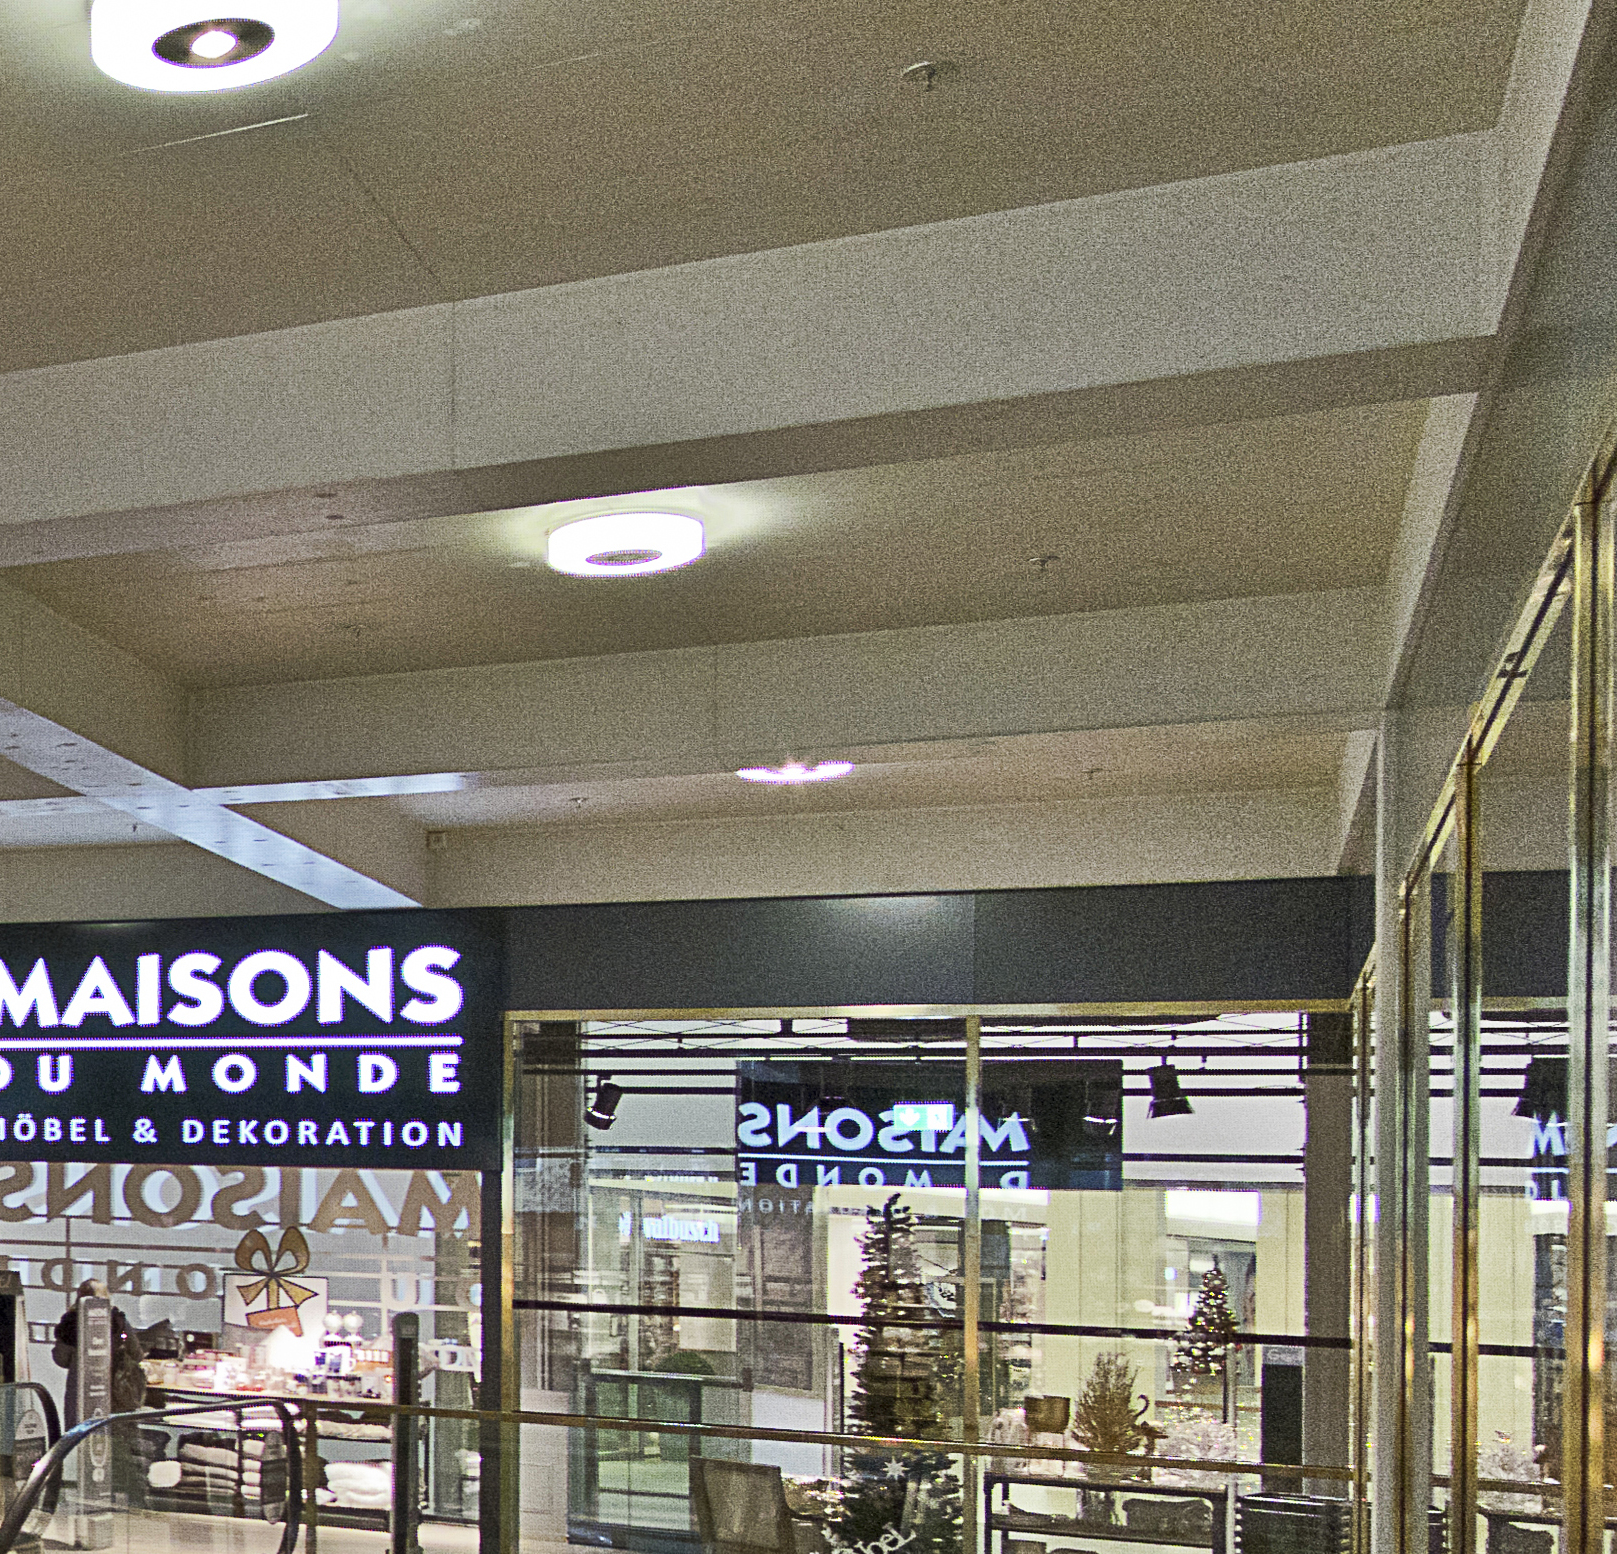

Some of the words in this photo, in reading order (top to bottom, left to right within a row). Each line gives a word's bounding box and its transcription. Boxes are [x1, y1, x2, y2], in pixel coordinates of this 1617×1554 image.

[140, 1052, 461, 1094] MONDE
[131, 1116, 159, 1144] &
[182, 1118, 463, 1147] DEKORATION
